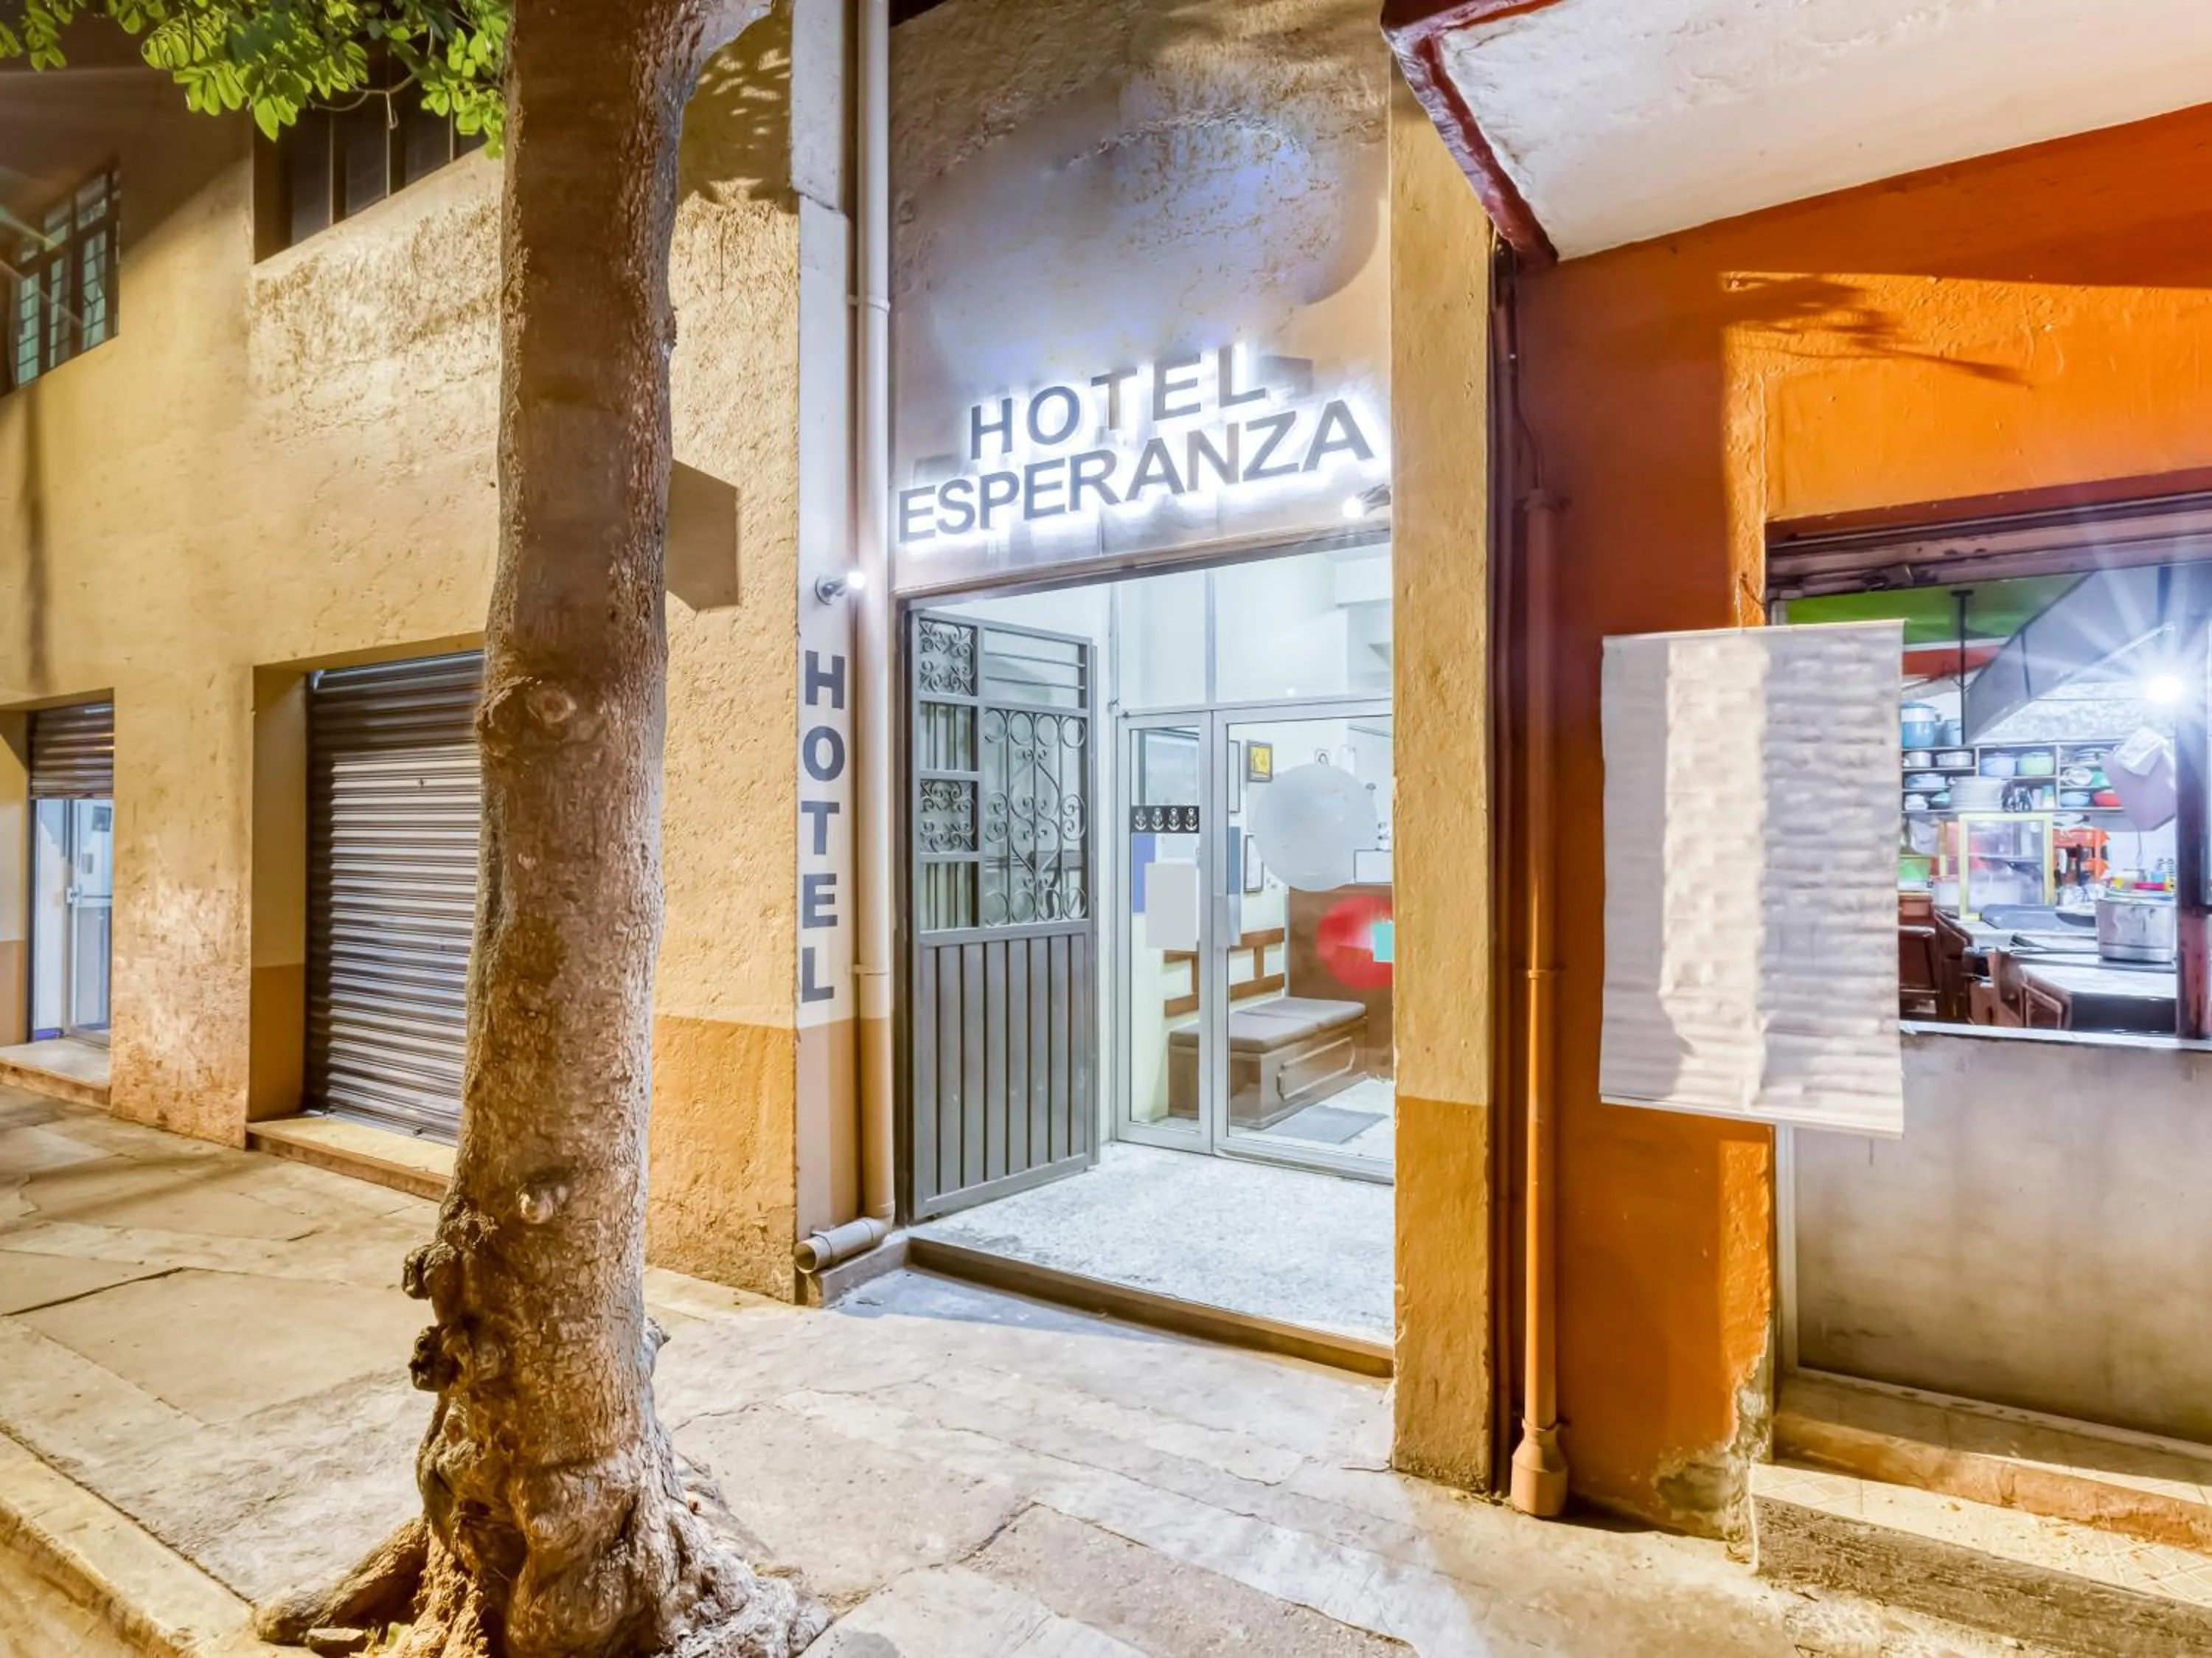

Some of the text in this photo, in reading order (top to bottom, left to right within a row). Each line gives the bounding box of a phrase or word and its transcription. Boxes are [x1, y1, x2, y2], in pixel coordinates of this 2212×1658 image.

[898, 398, 1375, 544] ESPERANZA
[970, 344, 1266, 460] HOTEL
[801, 650, 846, 1003] HOTEL
